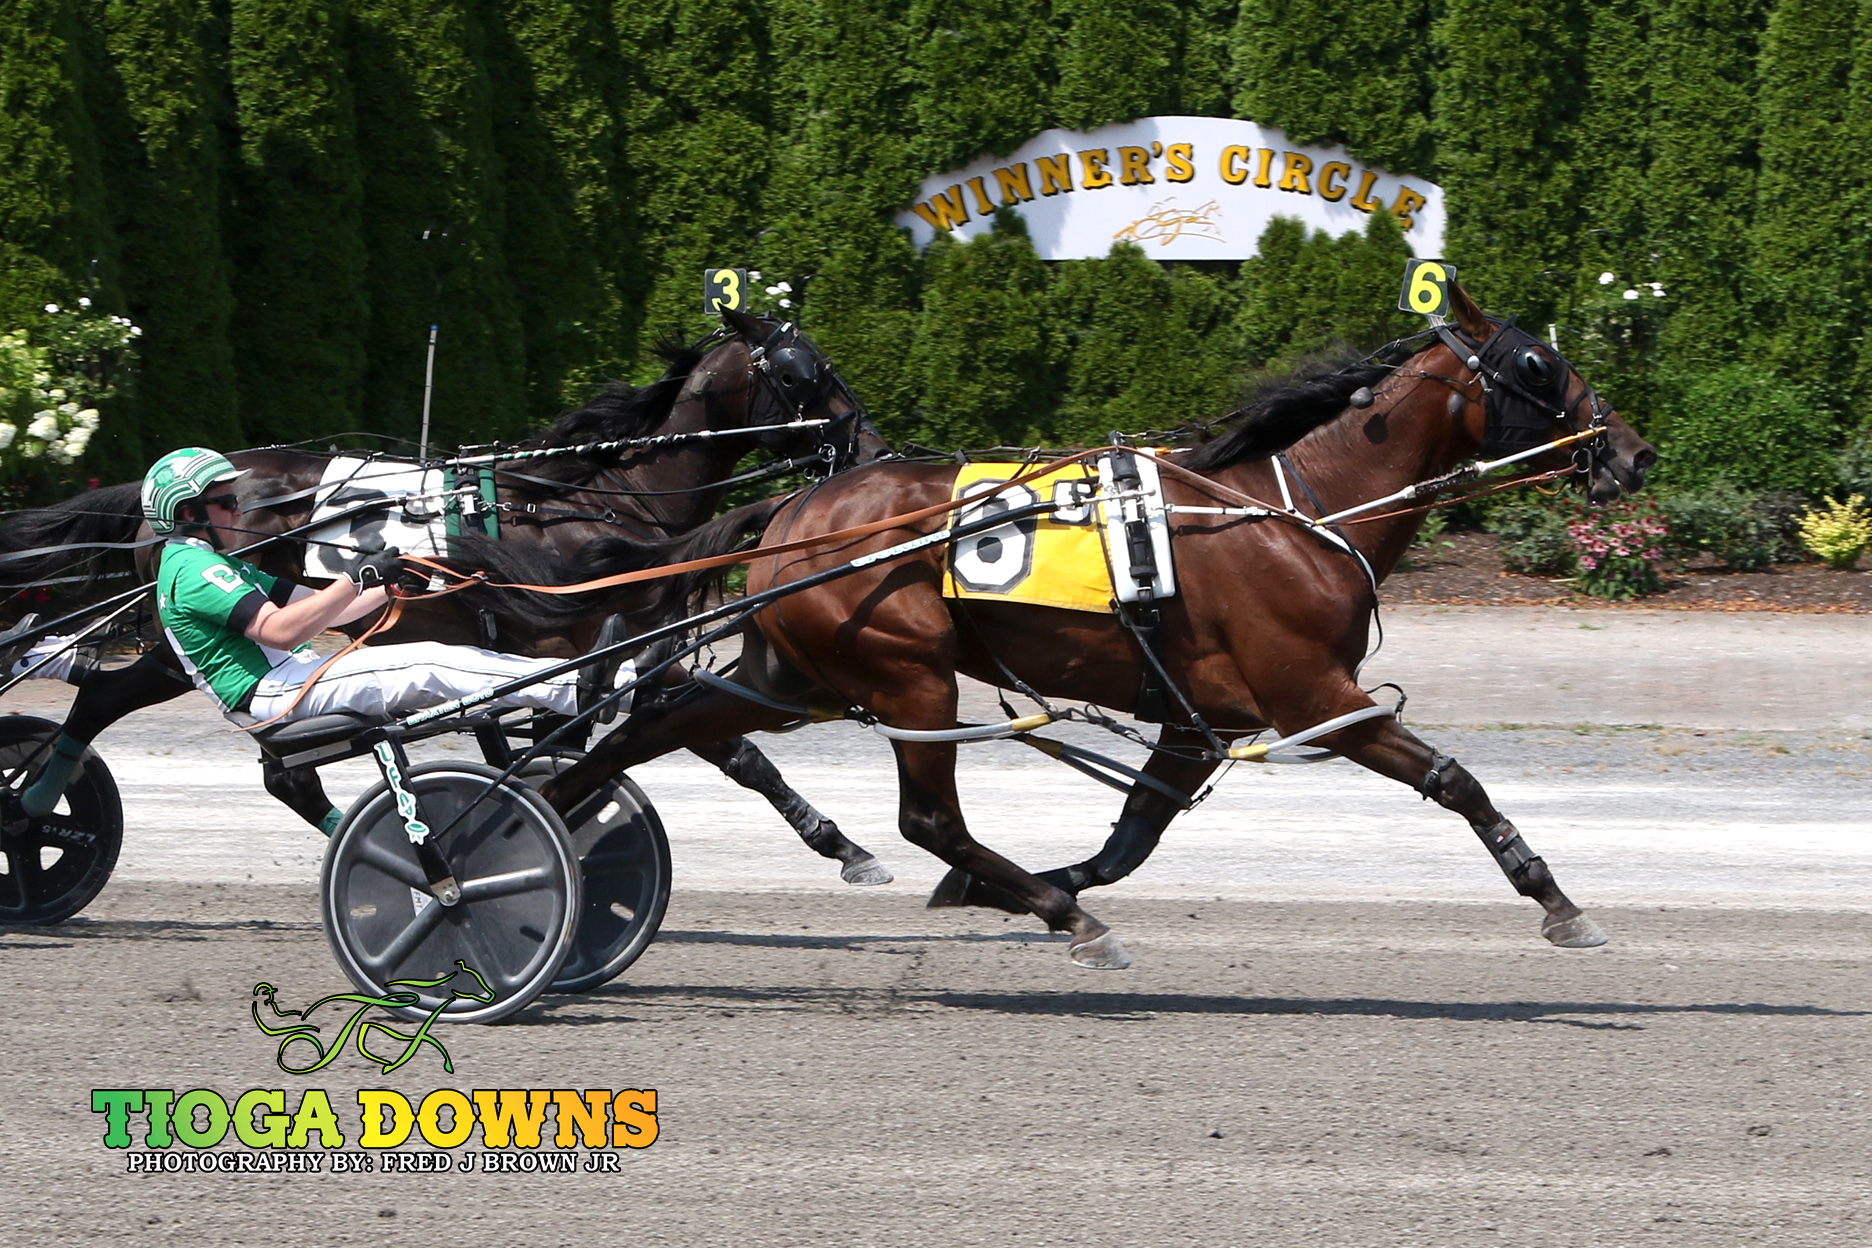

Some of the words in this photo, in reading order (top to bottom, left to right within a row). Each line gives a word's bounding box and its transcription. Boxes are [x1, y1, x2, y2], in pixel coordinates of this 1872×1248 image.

[913, 142, 1195, 231] WINNER'S
[1219, 144, 1428, 231] CIRCLE
[711, 269, 740, 311] 3
[1408, 262, 1447, 314] 6
[891, 531, 950, 554] ECLIPSE
